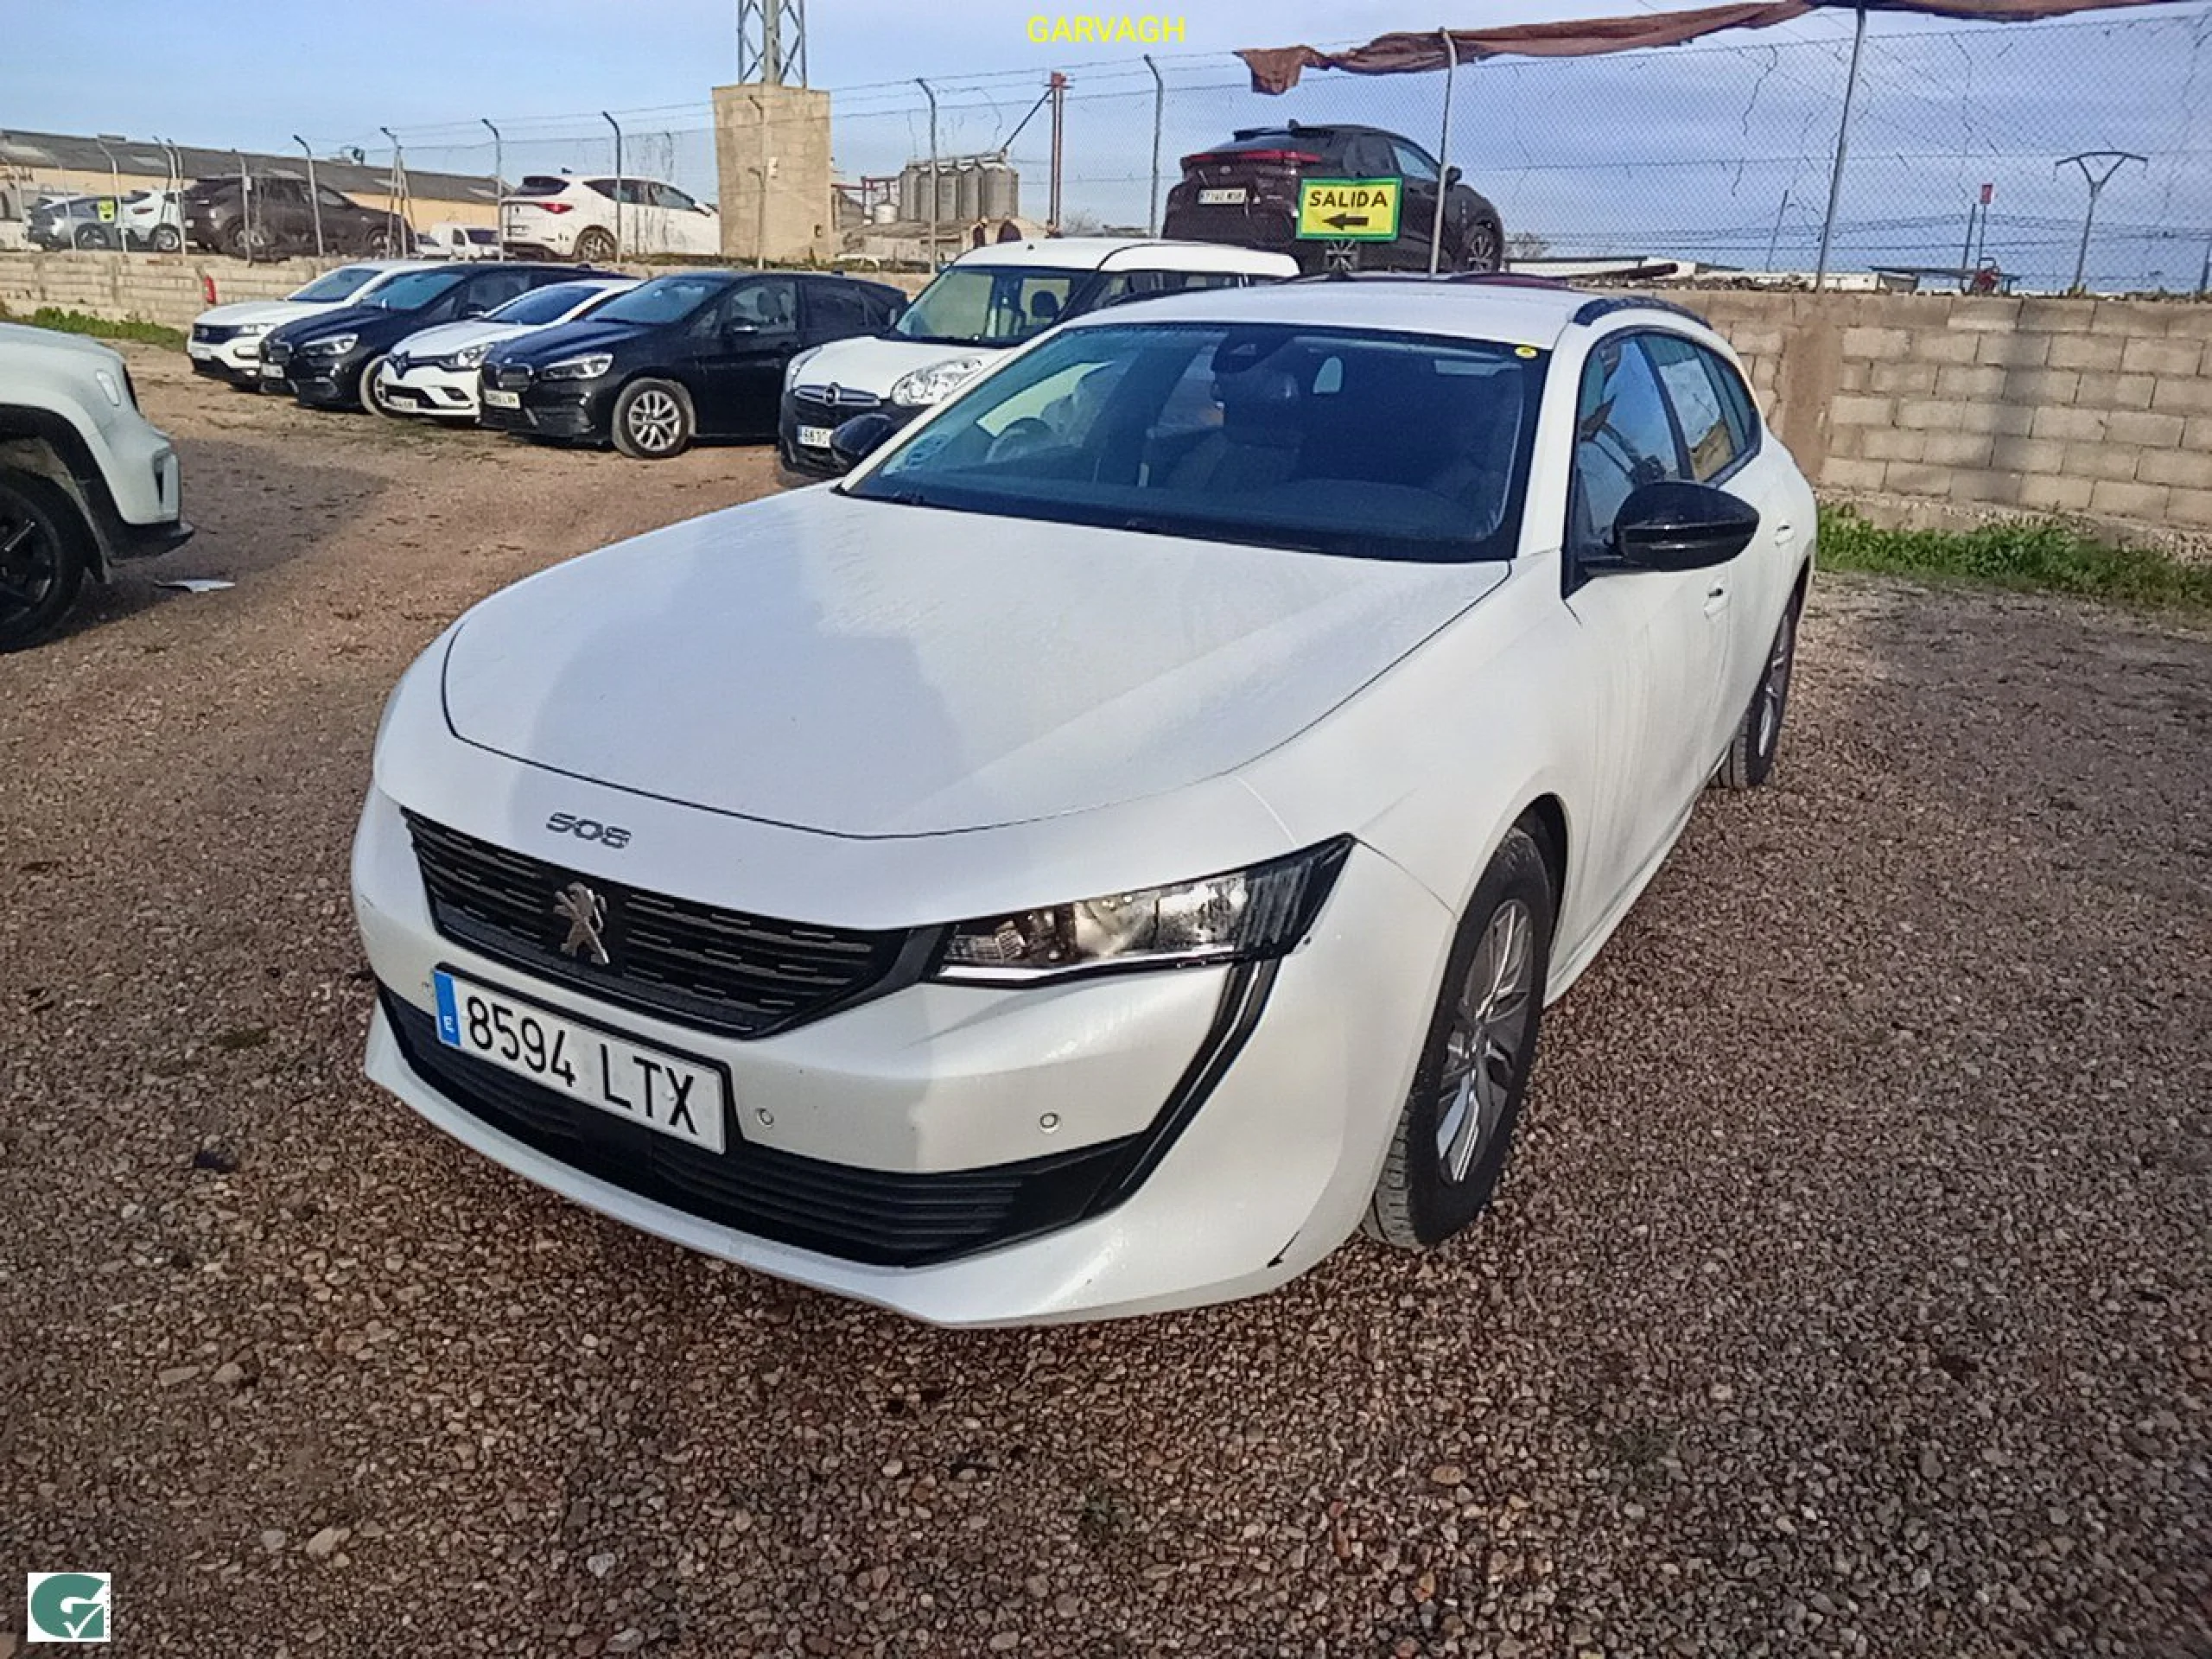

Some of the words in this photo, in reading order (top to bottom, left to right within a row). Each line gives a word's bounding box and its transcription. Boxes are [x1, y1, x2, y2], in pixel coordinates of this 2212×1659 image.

[1309, 189, 1388, 207] SALIDA
[546, 812, 631, 849] 508
[443, 1015, 454, 1033] E
[467, 996, 575, 1088] 8594
[600, 1043, 698, 1135] LTX
